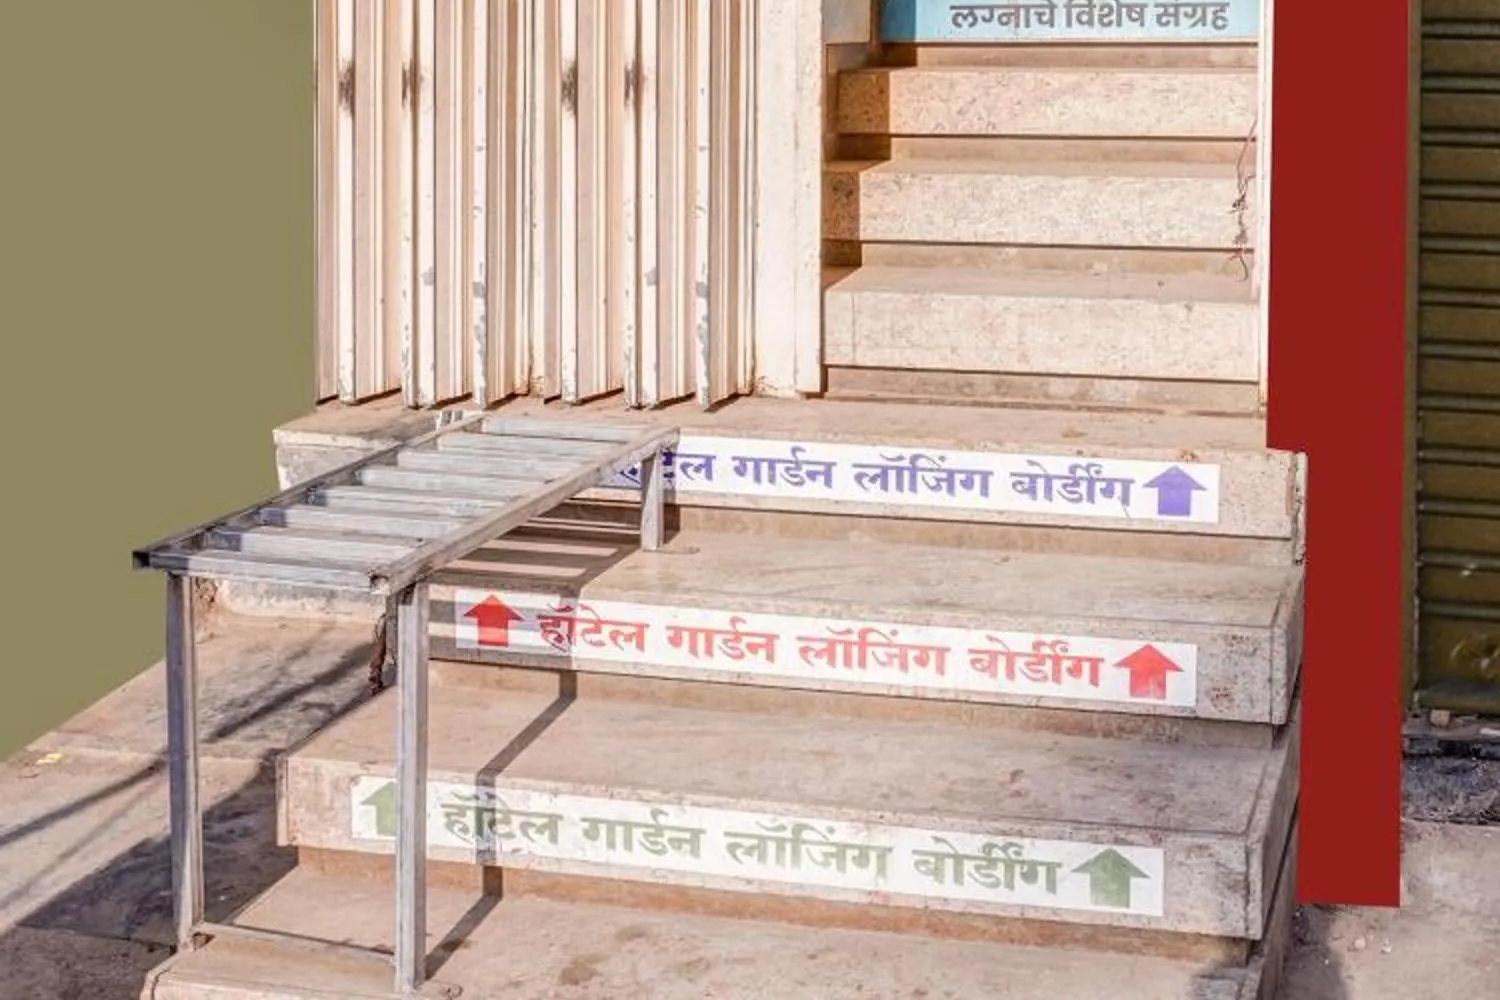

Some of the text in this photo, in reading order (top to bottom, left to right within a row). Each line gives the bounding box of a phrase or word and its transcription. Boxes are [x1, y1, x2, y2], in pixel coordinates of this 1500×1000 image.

[732, 446, 837, 488] गार्डन
[853, 453, 994, 498] लॉजिंग
[1010, 460, 1135, 506] बोर्डींग
[537, 603, 1104, 688] हॉटेल गार्डन लॉजिंग बोर्डींग
[440, 789, 1062, 896] हॉटेल गार्डन लॉजिंग बोर्डींग
